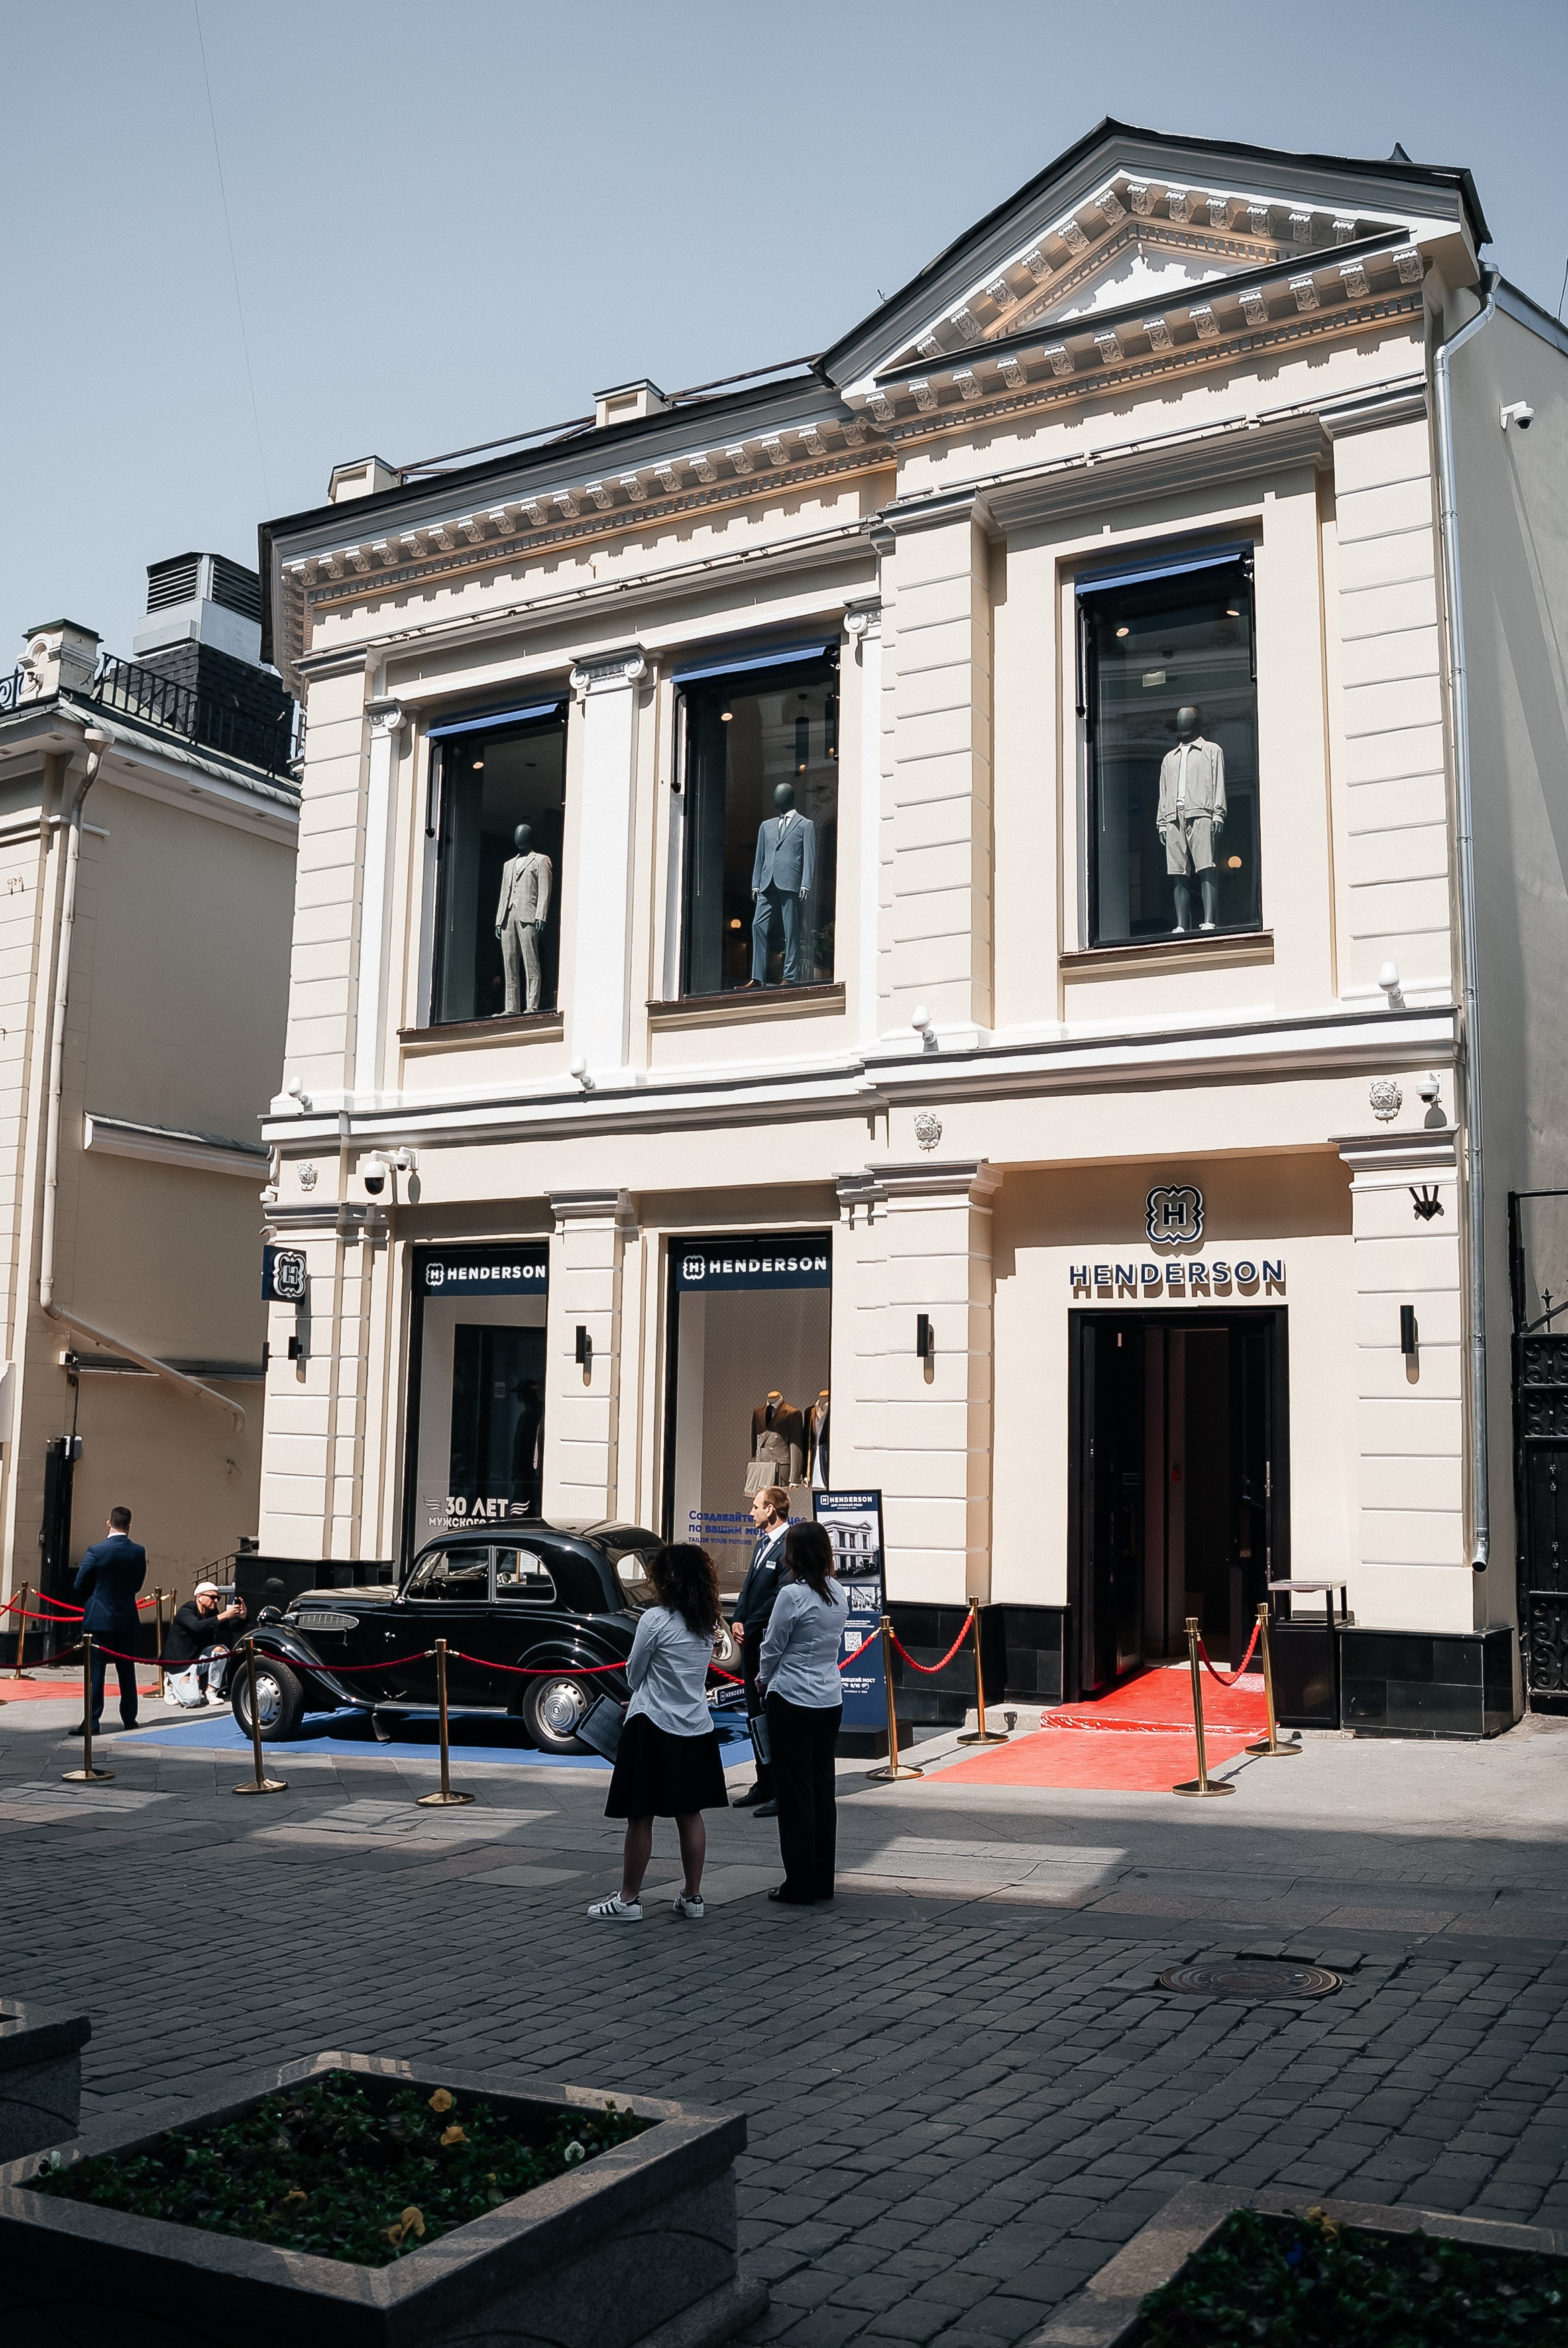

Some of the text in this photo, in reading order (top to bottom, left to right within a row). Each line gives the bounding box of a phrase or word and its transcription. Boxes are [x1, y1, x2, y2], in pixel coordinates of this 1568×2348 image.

[1162, 1202, 1186, 1226] H
[447, 1265, 545, 1280] HENDERSON
[710, 1257, 826, 1273] HENDERSON
[1070, 1260, 1284, 1285] HENDERSON
[445, 1497, 509, 1517] 30 ЛЕТ
[689, 1510, 754, 1522] Создавайте
[689, 1524, 702, 1532] по
[706, 1525, 742, 1534] вашим
[725, 1688, 744, 1697] HENDERS
